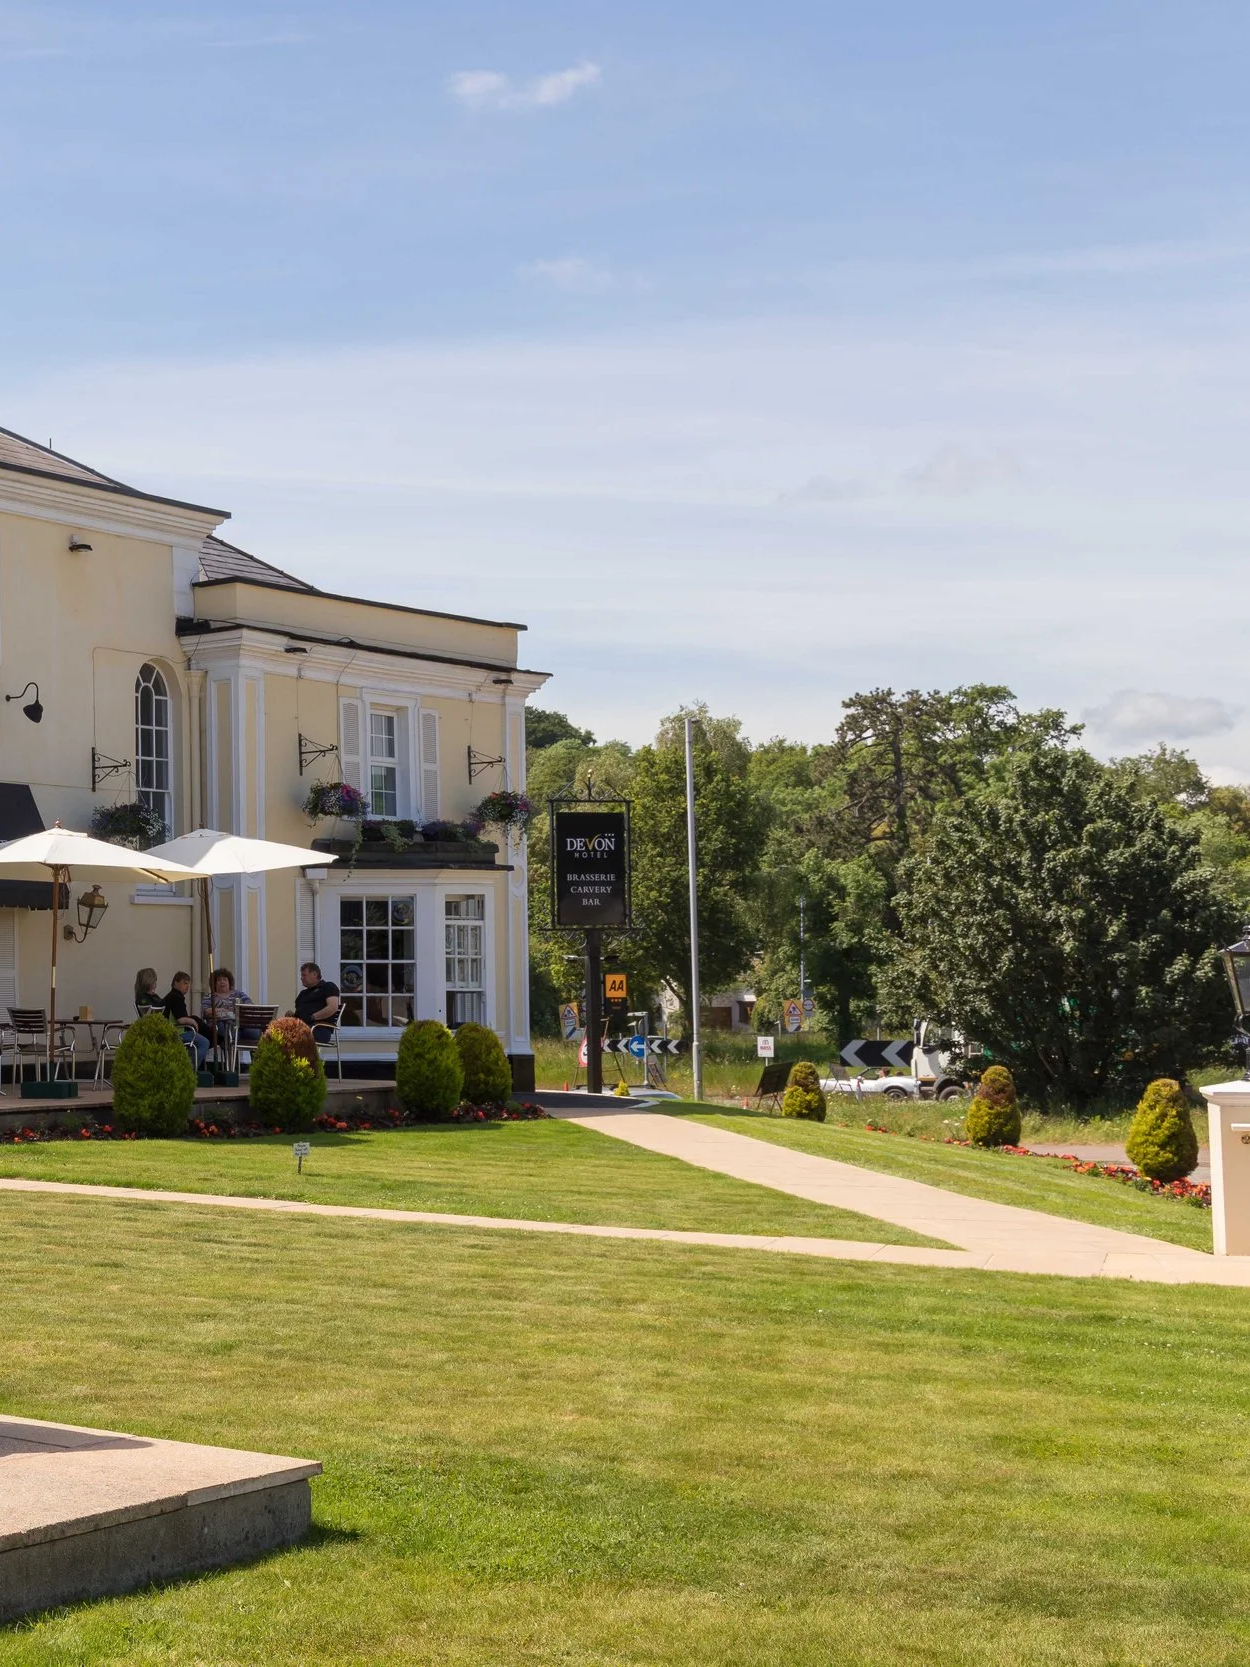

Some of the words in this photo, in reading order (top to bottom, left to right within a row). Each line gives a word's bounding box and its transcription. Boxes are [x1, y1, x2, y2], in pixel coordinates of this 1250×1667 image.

[566, 833, 616, 851] DEVON
[574, 851, 608, 859] HOTEL
[566, 873, 617, 881] BRASSERIE
[570, 886, 613, 894] CARVERY
[582, 898, 602, 906] BAR
[609, 980, 625, 992] AA
